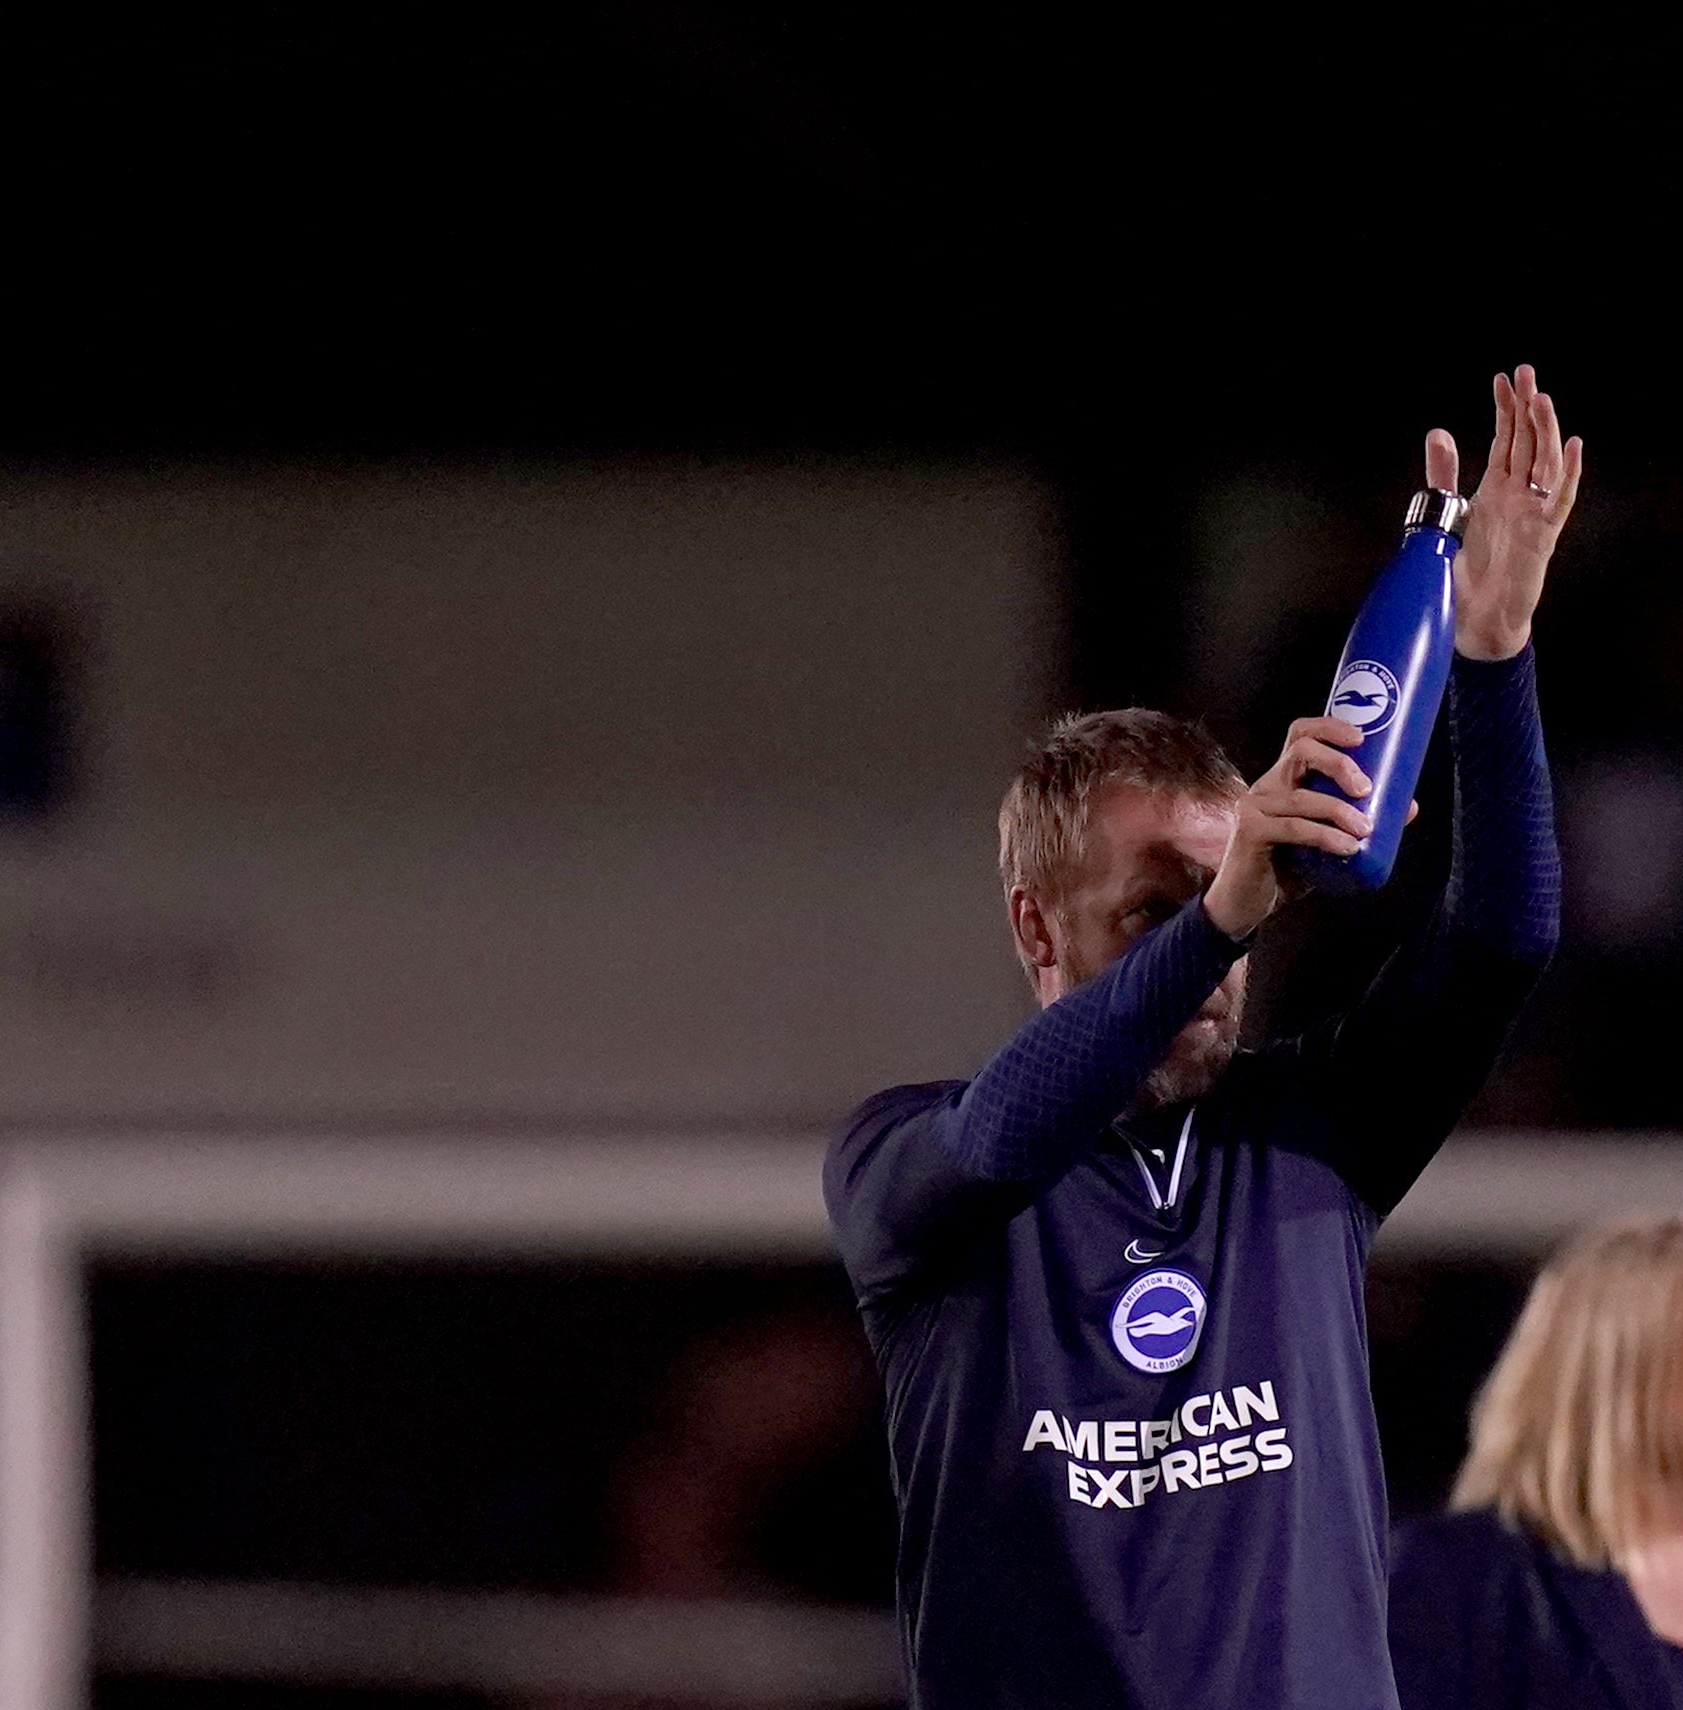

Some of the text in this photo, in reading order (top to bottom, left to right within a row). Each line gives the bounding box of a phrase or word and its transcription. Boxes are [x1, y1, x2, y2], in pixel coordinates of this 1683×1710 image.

[1122, 1275, 1198, 1309] BRIGHTON & HOVE
[1145, 1357, 1184, 1371] ALBION
[1022, 1380, 1281, 1462] AMERICAN
[1067, 1427, 1294, 1509] EXPRESS
